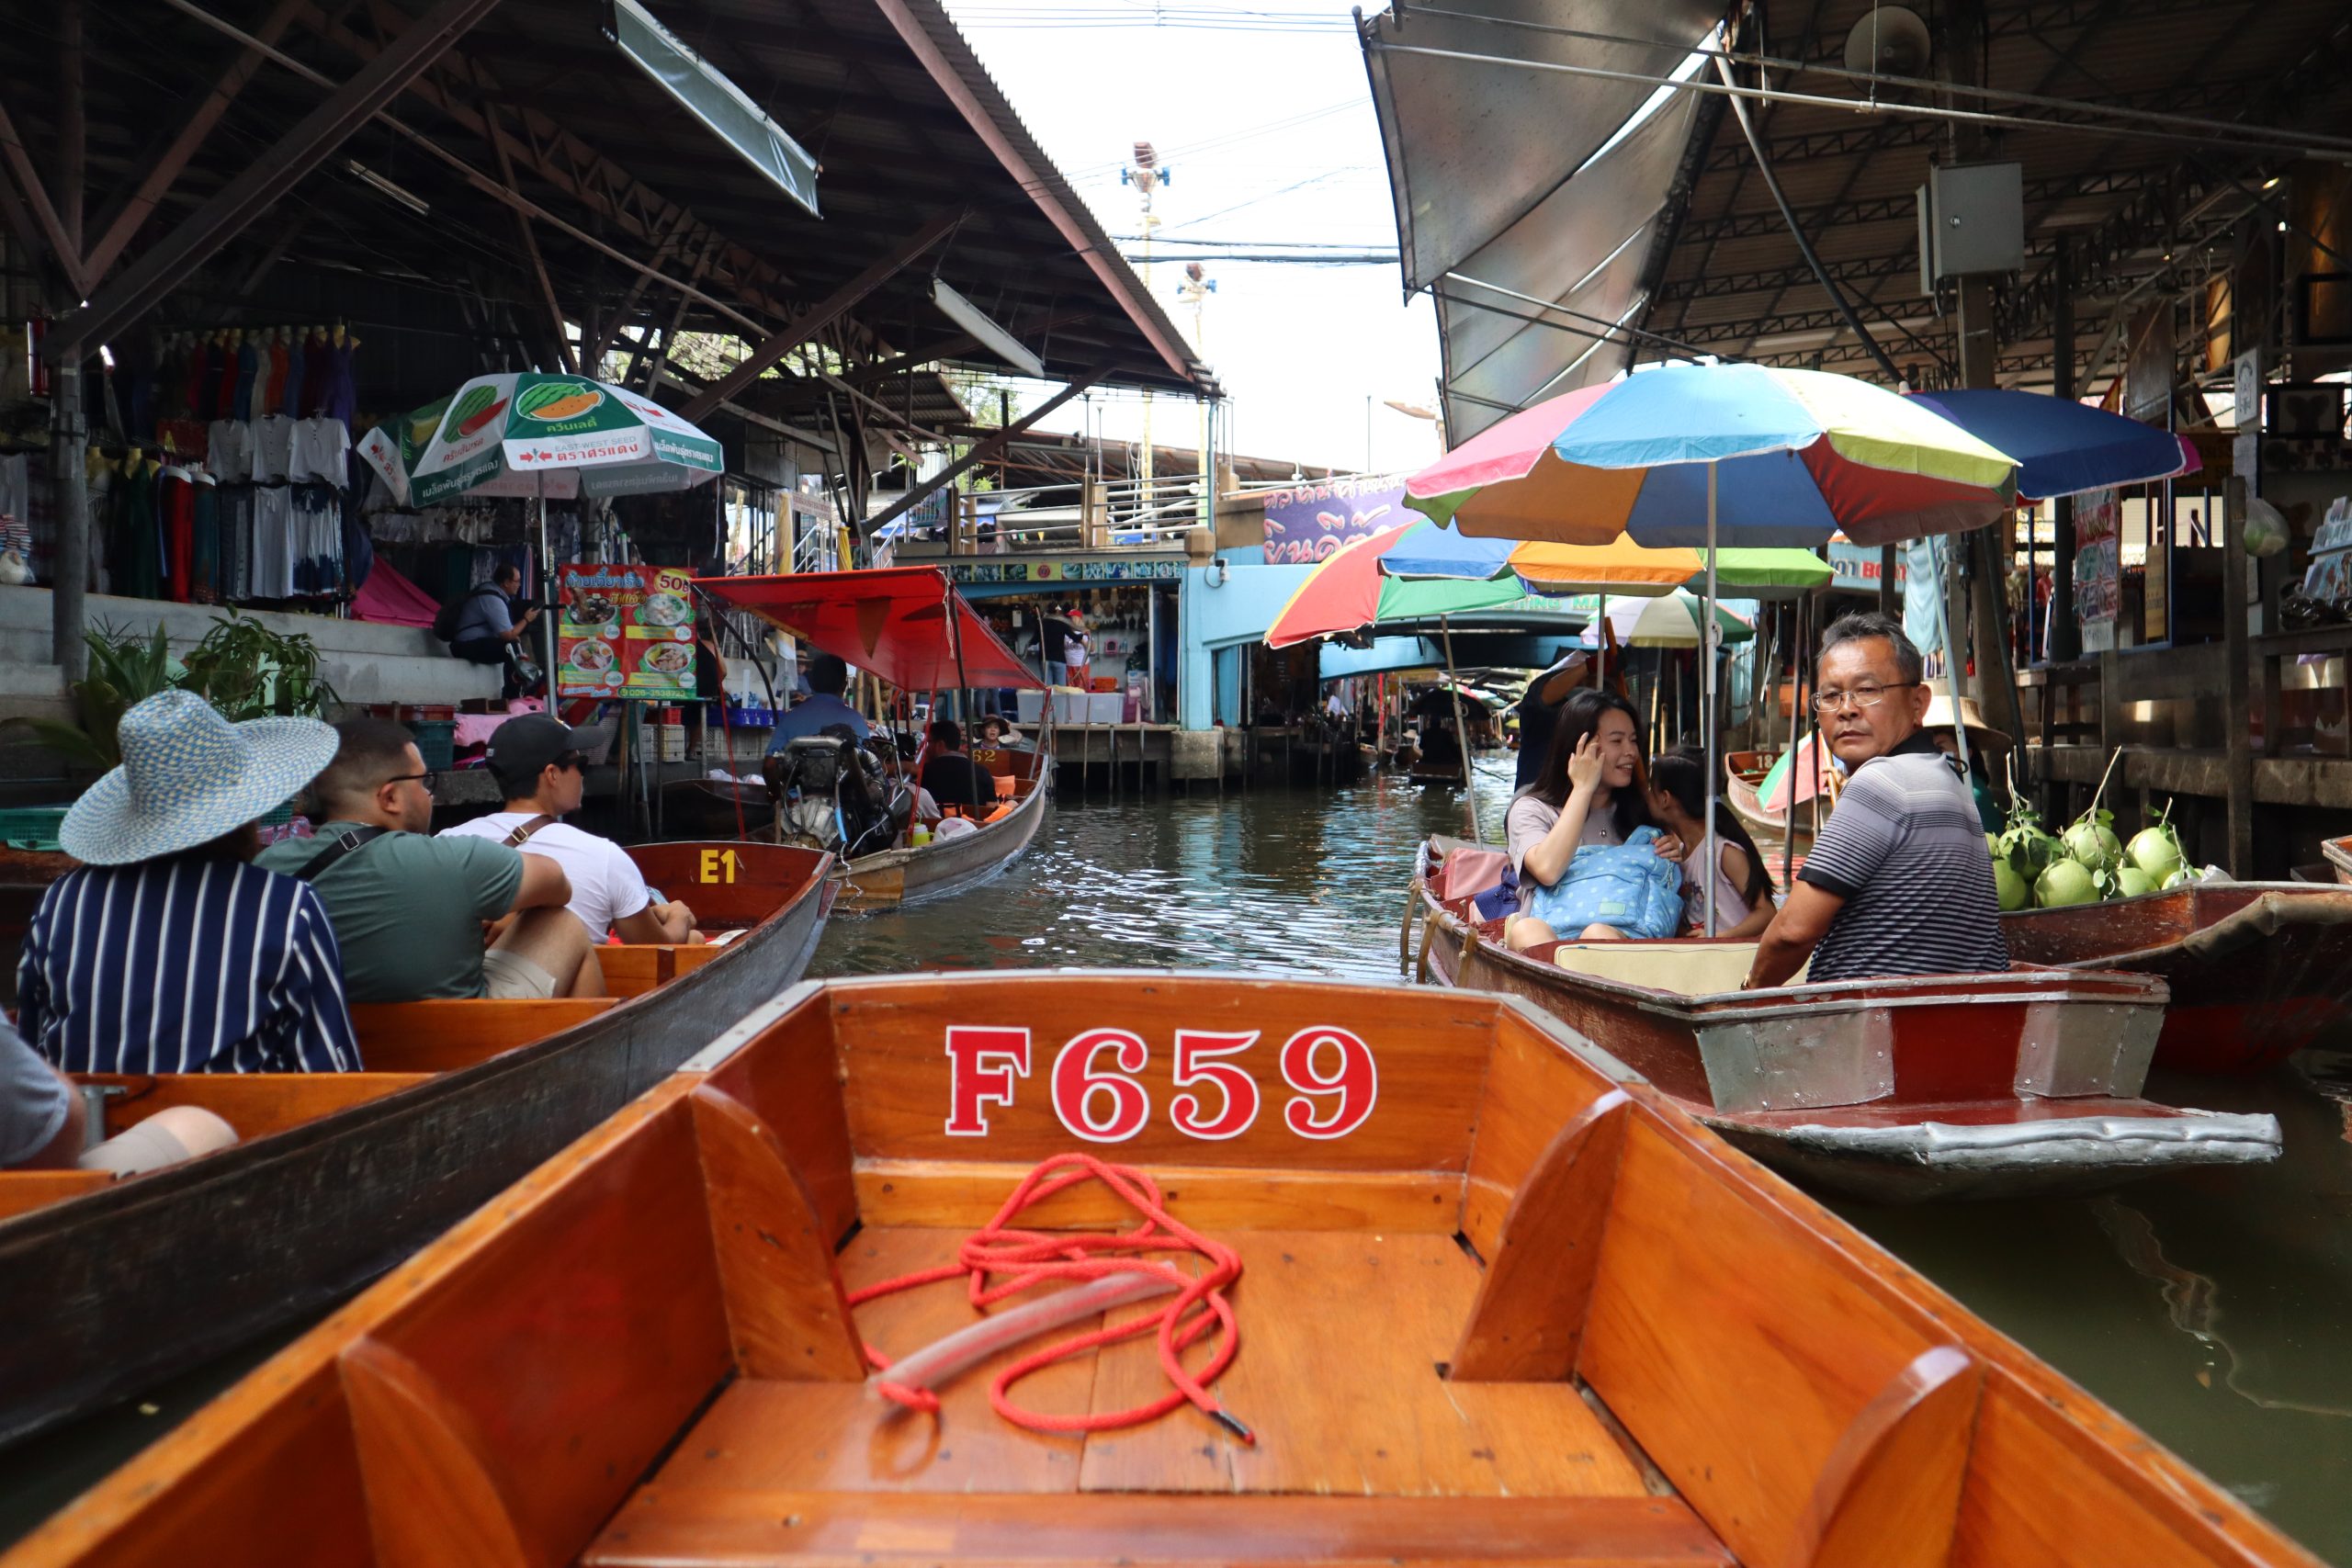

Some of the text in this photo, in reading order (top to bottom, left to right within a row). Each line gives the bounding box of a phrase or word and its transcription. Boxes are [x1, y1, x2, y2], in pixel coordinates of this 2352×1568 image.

[555, 435, 637, 452] EAST-WEST SEED
[557, 443, 639, 461] ตราศรแดง
[1572, 595, 1600, 610] MA
[700, 849, 735, 884] E1
